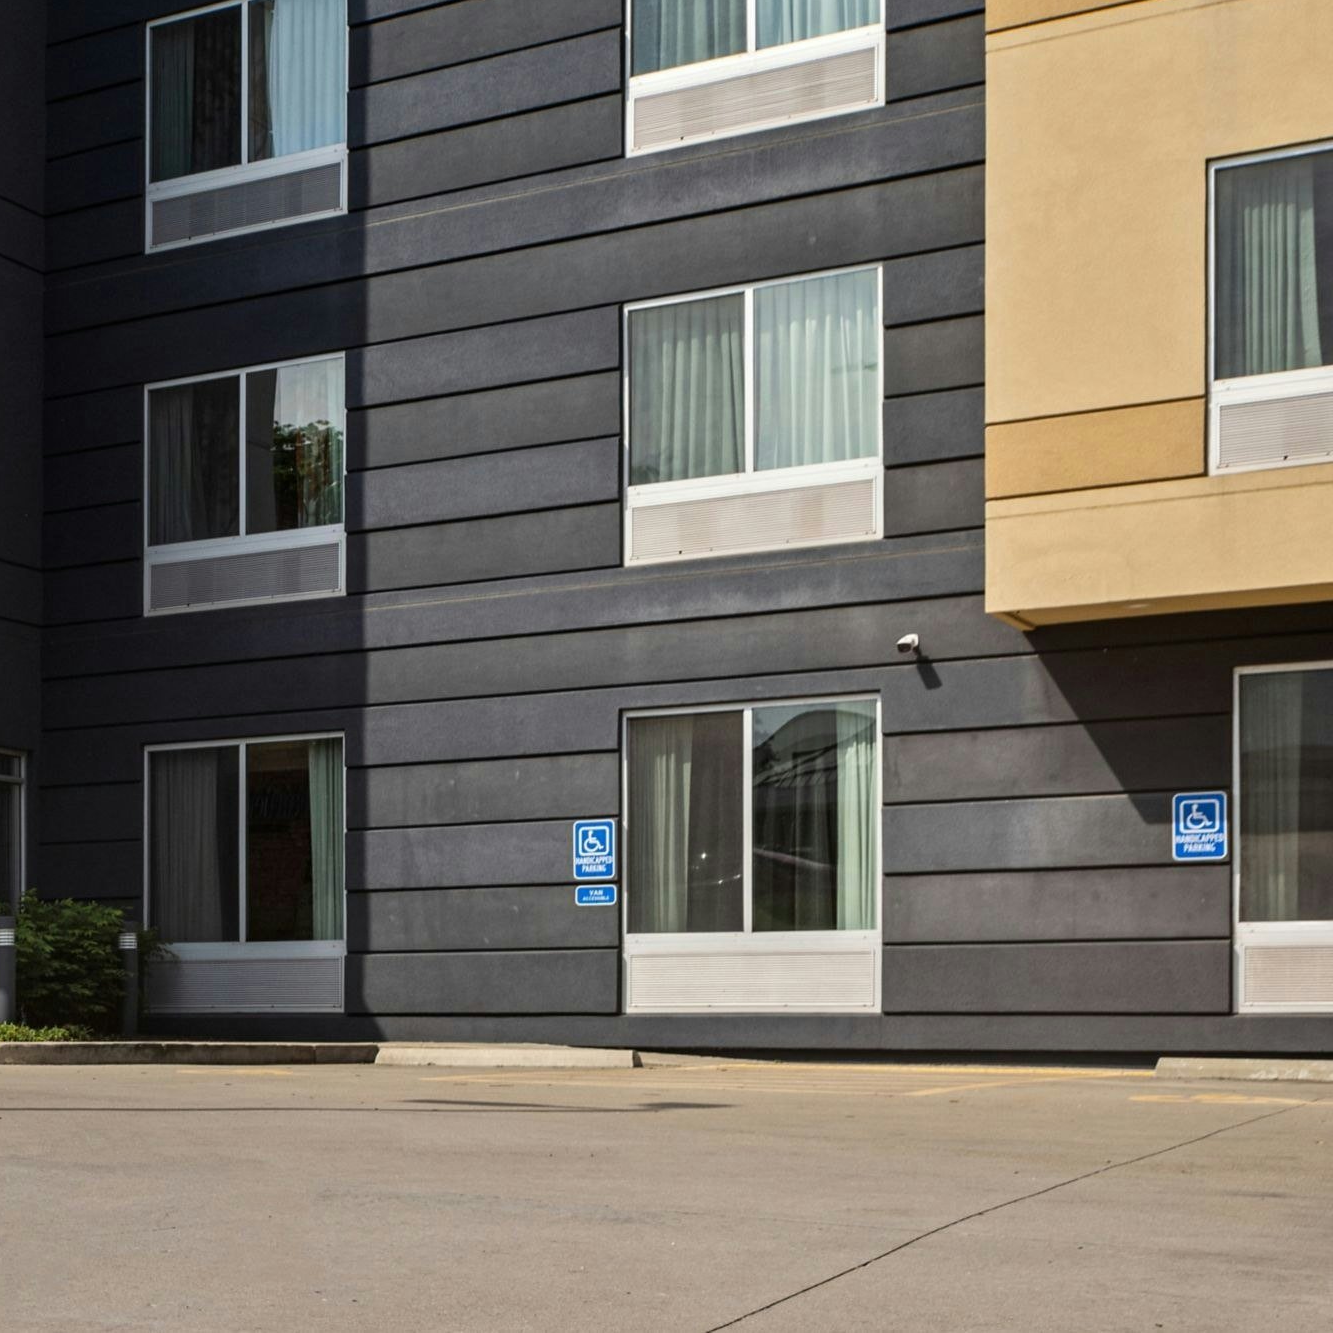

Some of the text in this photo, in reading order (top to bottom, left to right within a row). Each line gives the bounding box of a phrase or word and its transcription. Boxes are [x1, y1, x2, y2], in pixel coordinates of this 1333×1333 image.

[1183, 842, 1216, 853] PARKING
[575, 856, 614, 865] HANDICAPPED
[581, 864, 607, 873] PARKING
